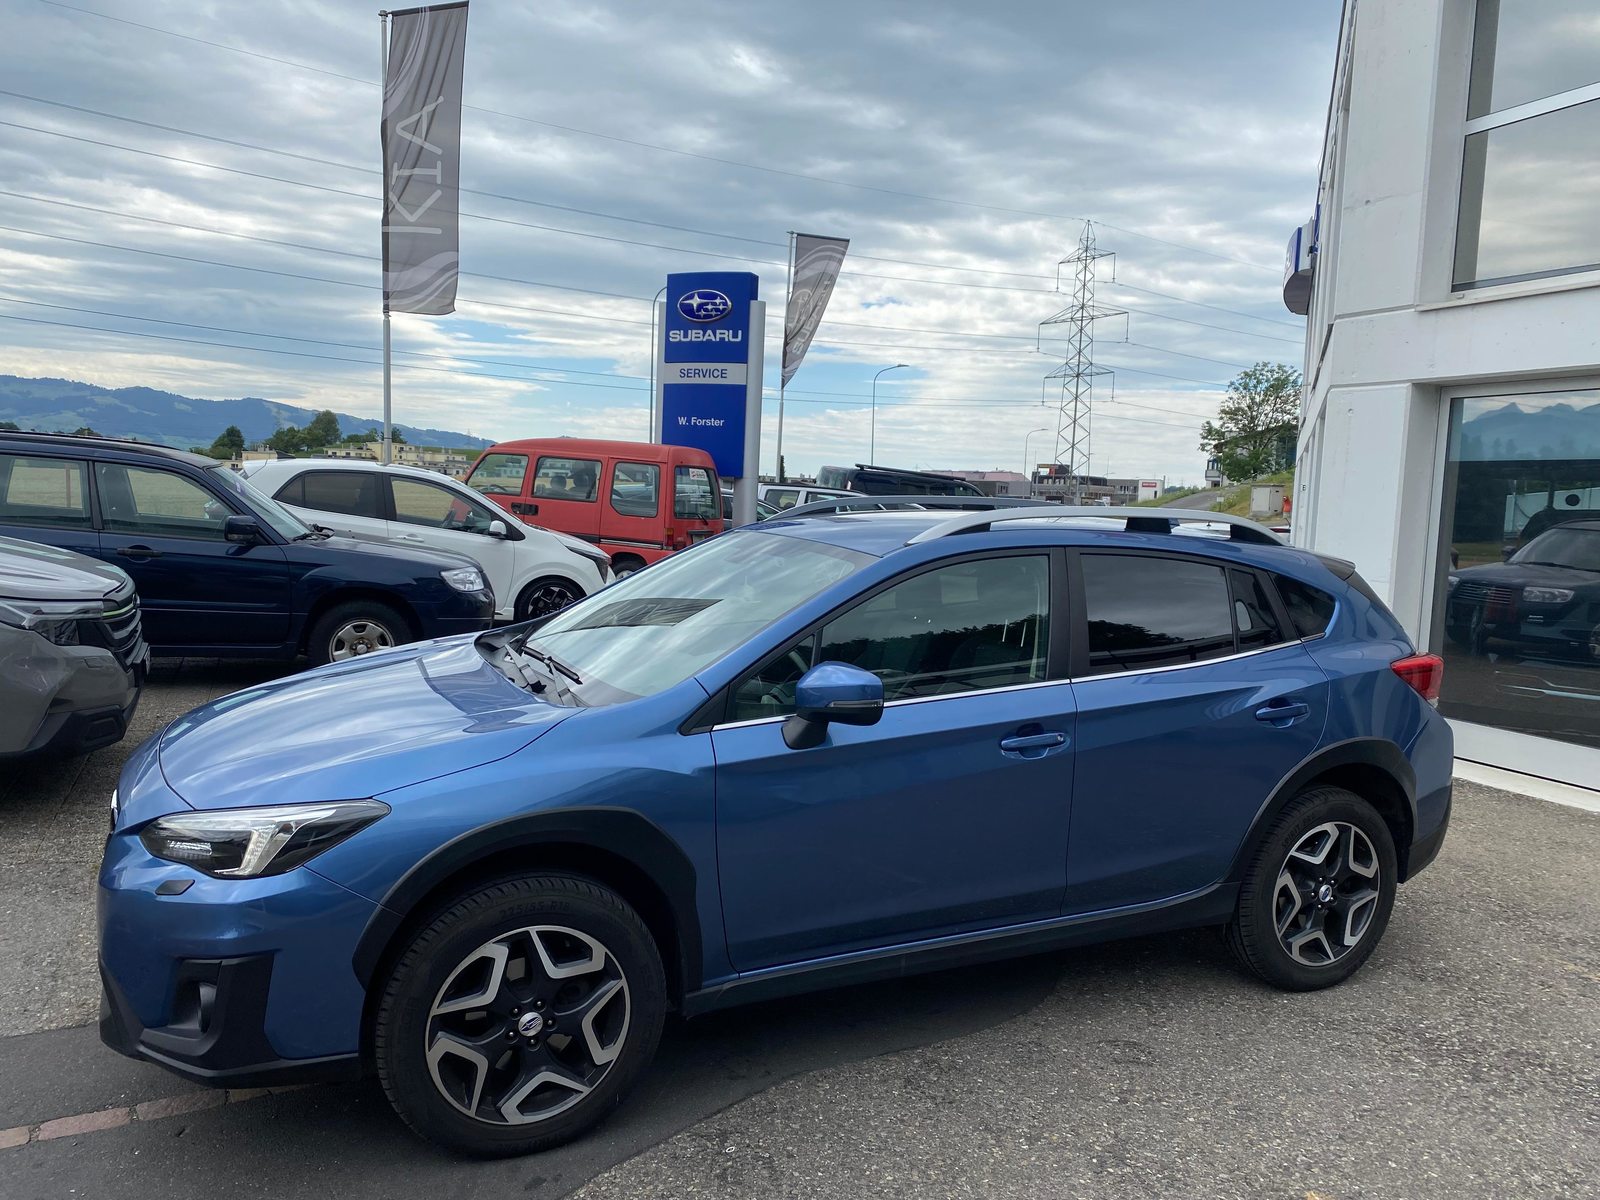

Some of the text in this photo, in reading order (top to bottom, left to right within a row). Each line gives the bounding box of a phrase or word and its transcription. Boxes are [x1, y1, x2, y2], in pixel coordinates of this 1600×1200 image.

[383, 96, 444, 233] KIA
[669, 329, 742, 342] SUBARU
[679, 368, 728, 379] SERVICE
[678, 416, 725, 427] W. Forster
